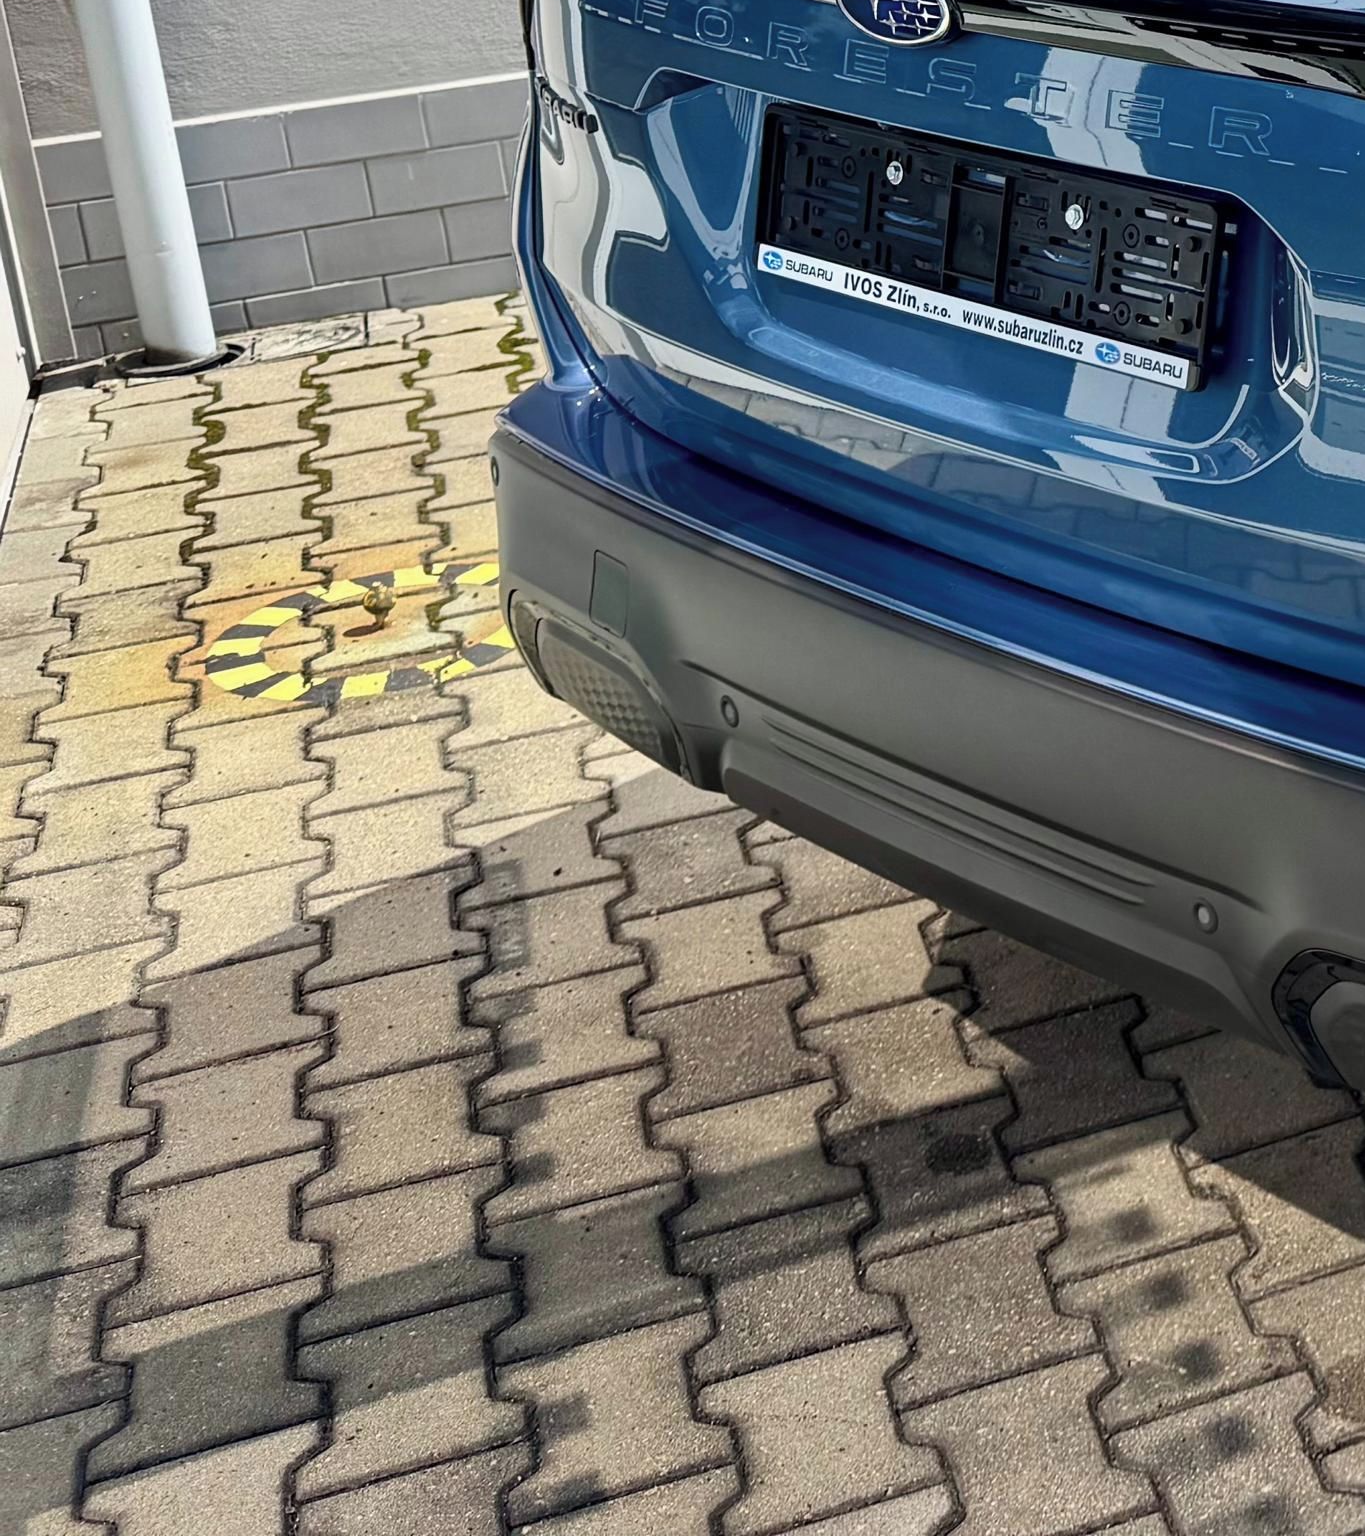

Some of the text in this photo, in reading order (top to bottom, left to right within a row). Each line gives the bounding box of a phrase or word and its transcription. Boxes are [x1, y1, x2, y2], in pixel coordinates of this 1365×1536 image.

[785, 259, 1184, 379] SUBARU IVOS Zlín, s.r.o. www.subaruzlin.cz SUBARU
